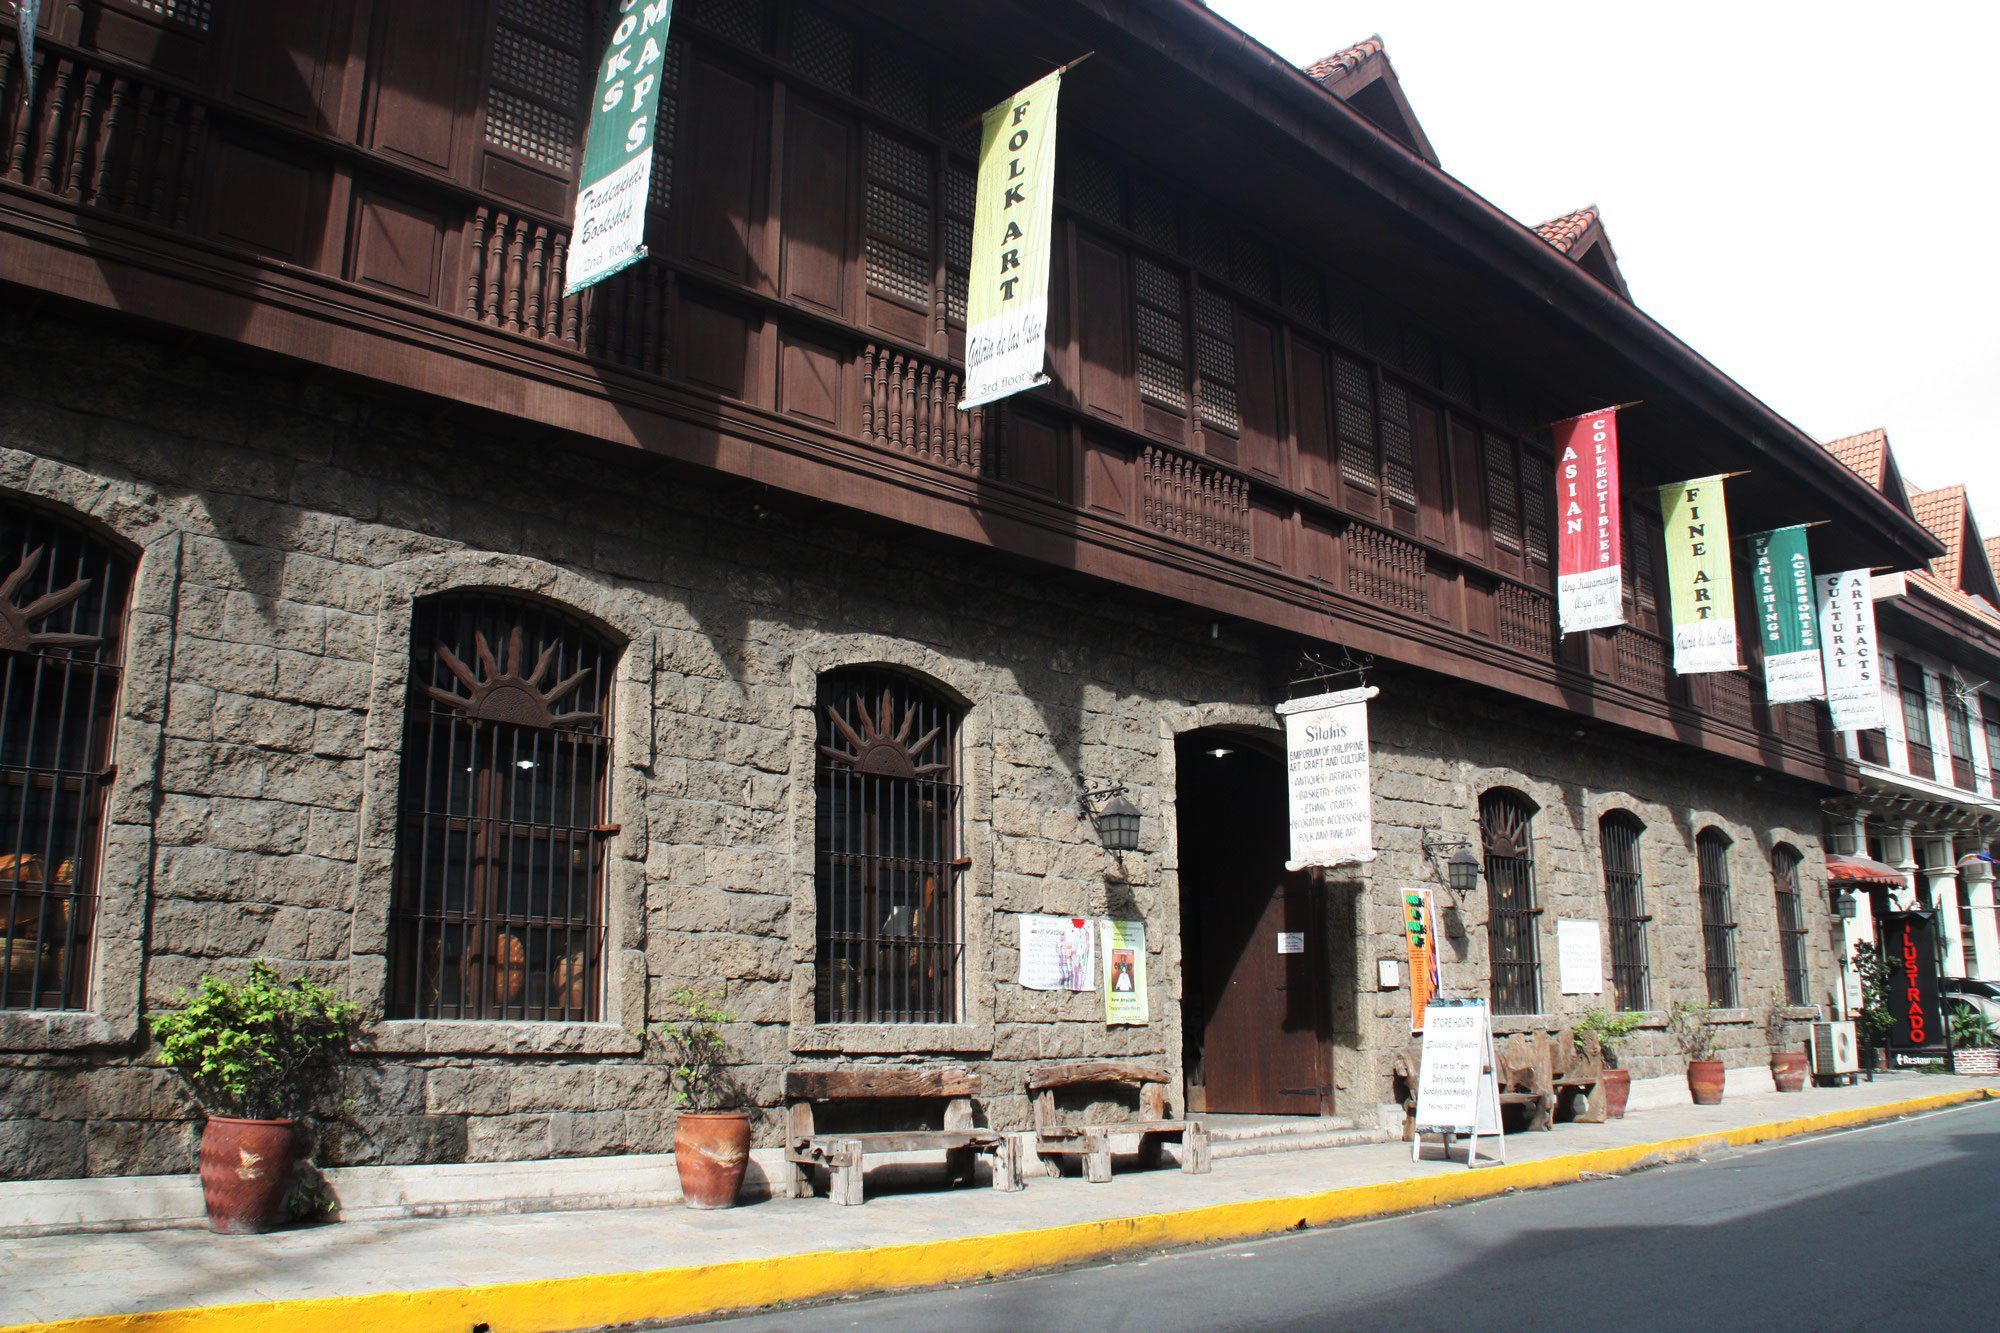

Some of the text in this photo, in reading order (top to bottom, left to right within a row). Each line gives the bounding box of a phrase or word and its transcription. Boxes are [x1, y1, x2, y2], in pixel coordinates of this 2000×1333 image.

[626, 0, 668, 152] MAPS
[583, 163, 644, 217] Tradewinds
[1000, 101, 1031, 301] FOLK ART
[582, 199, 632, 245] Bookshop
[584, 239, 630, 272] 2nd floor
[980, 373, 1026, 395] 3rd floor
[1562, 446, 1582, 534] ASIAN
[1592, 419, 1610, 563] COLLECTIBLES
[1686, 487, 1711, 620] FINE ART
[1756, 537, 1779, 641] FURNISHINGS
[1791, 553, 1813, 646] ACCESSORIES
[1579, 614, 1611, 625] 3rd floor
[1828, 577, 1846, 668] CULTURAL
[1850, 578, 1870, 681] ARTIFACTS
[1704, 659, 1722, 668] floor
[1768, 653, 1818, 669] Silahis Arts
[1779, 671, 1814, 682] Artifacts
[1831, 690, 1879, 702] Silahis Arts
[1840, 705, 1875, 716] Artifacts
[1305, 722, 1348, 743] Silahis
[1289, 740, 1364, 761] EMPORIUM OF PHILIPPINE
[1304, 758, 1324, 771] CRAFT
[1325, 755, 1339, 767] AND
[1340, 751, 1366, 765] CULTURE
[1294, 768, 1362, 787] ANTIQUES ARTIFACTS
[1299, 783, 1357, 800] BASKETRY BOOKS
[1304, 799, 1354, 814] ETHNIC CRAFTS
[1327, 811, 1367, 825] ACCESSORIES
[1299, 826, 1357, 843] FOLK AND FINE ART
[1903, 921, 1925, 1043] ILUSTRADO
[1433, 1017, 1474, 1028] STORE HOURS
[1425, 1039, 1478, 1050] Silahis Center
[1432, 1062, 1439, 1070] 10
[1432, 1075, 1465, 1086] Daily including
[1423, 1087, 1473, 1098] Sundays and Holidays
